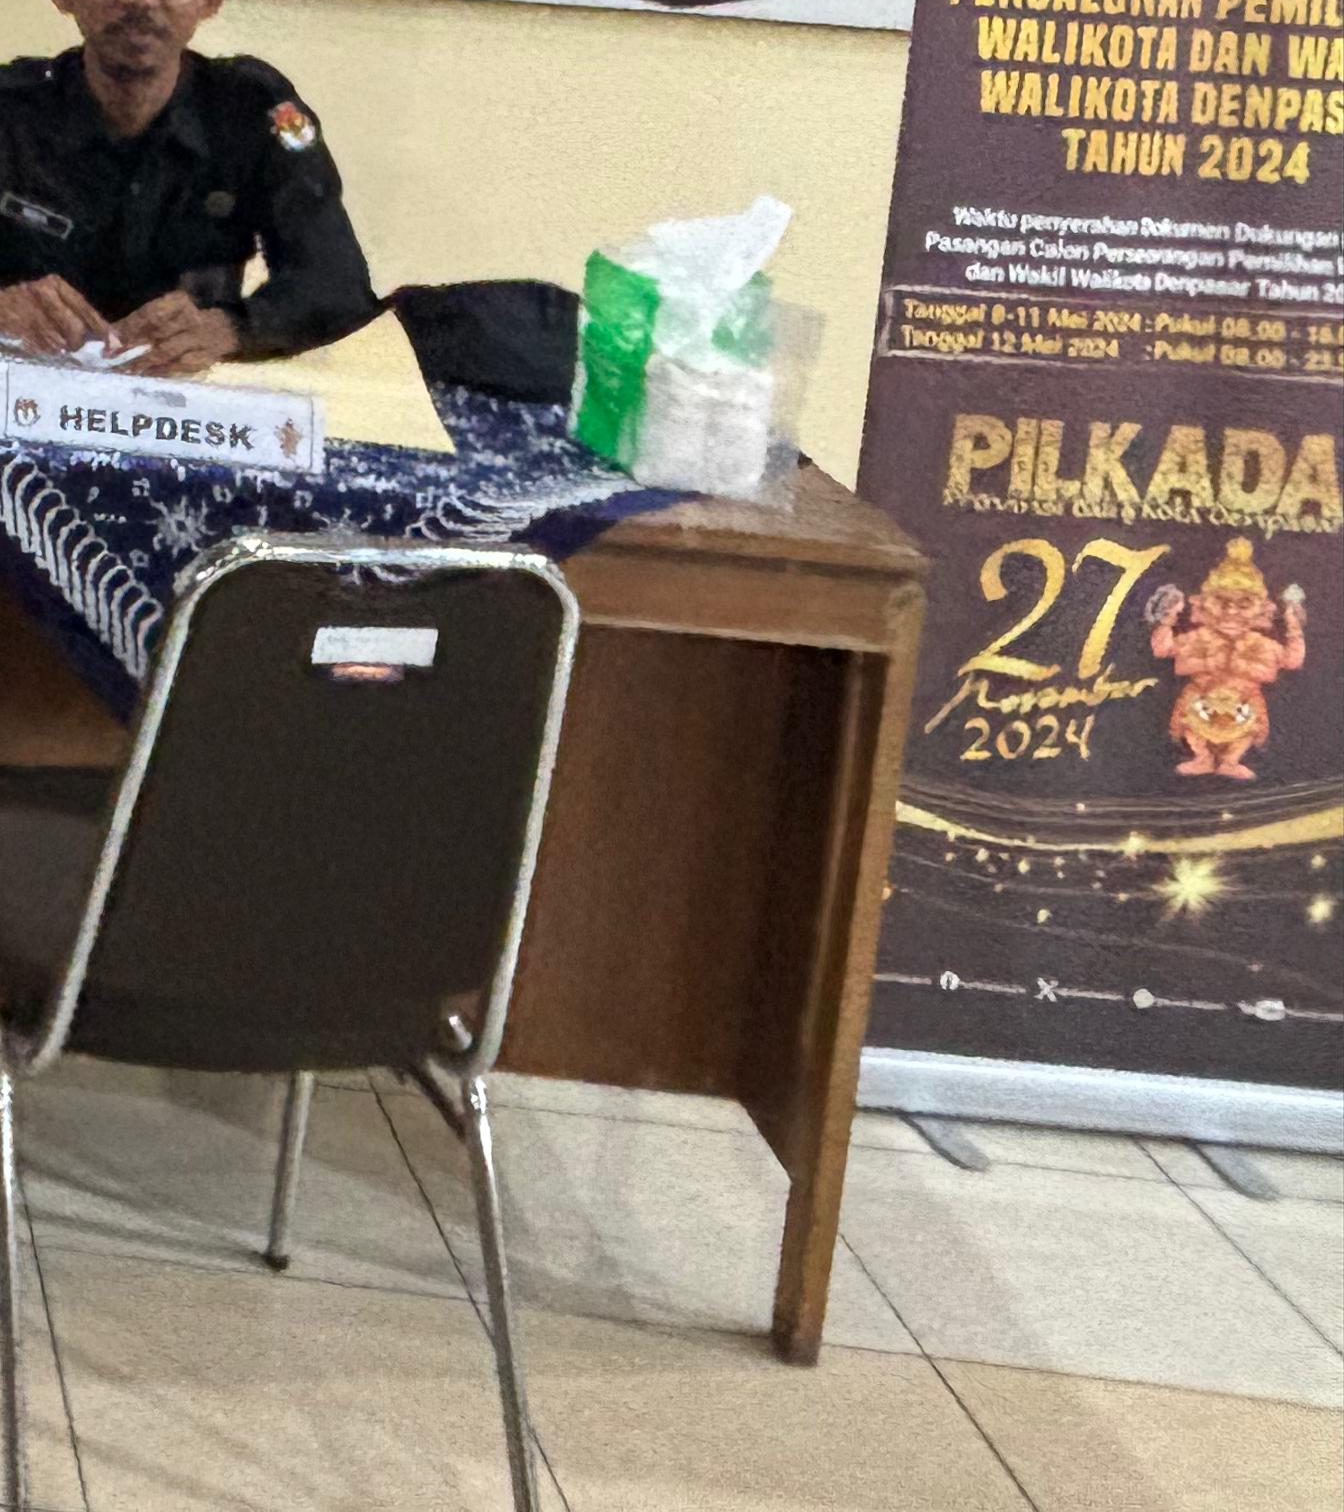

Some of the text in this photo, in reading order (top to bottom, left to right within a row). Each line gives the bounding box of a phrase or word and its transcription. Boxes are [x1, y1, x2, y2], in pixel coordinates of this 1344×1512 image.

[977, 16, 1178, 71] WALIKOTA
[1189, 29, 1272, 76] DAN
[980, 70, 1179, 124] WALIKOTA
[1061, 128, 1312, 185] TAHUN 2024
[952, 205, 1019, 230] Waktu
[924, 230, 1027, 260] Pasangan
[1029, 237, 1090, 261] Calon
[964, 261, 1006, 283] dan
[1008, 263, 1066, 287] Wakil
[1255, 278, 1320, 303] Tahun
[904, 298, 988, 326] Tanggal
[901, 324, 985, 353] Tanggal
[59, 404, 256, 451] HELPDESK
[945, 414, 1342, 526] PILKADA
[957, 536, 1172, 680] 27
[959, 714, 1096, 761] 2024
